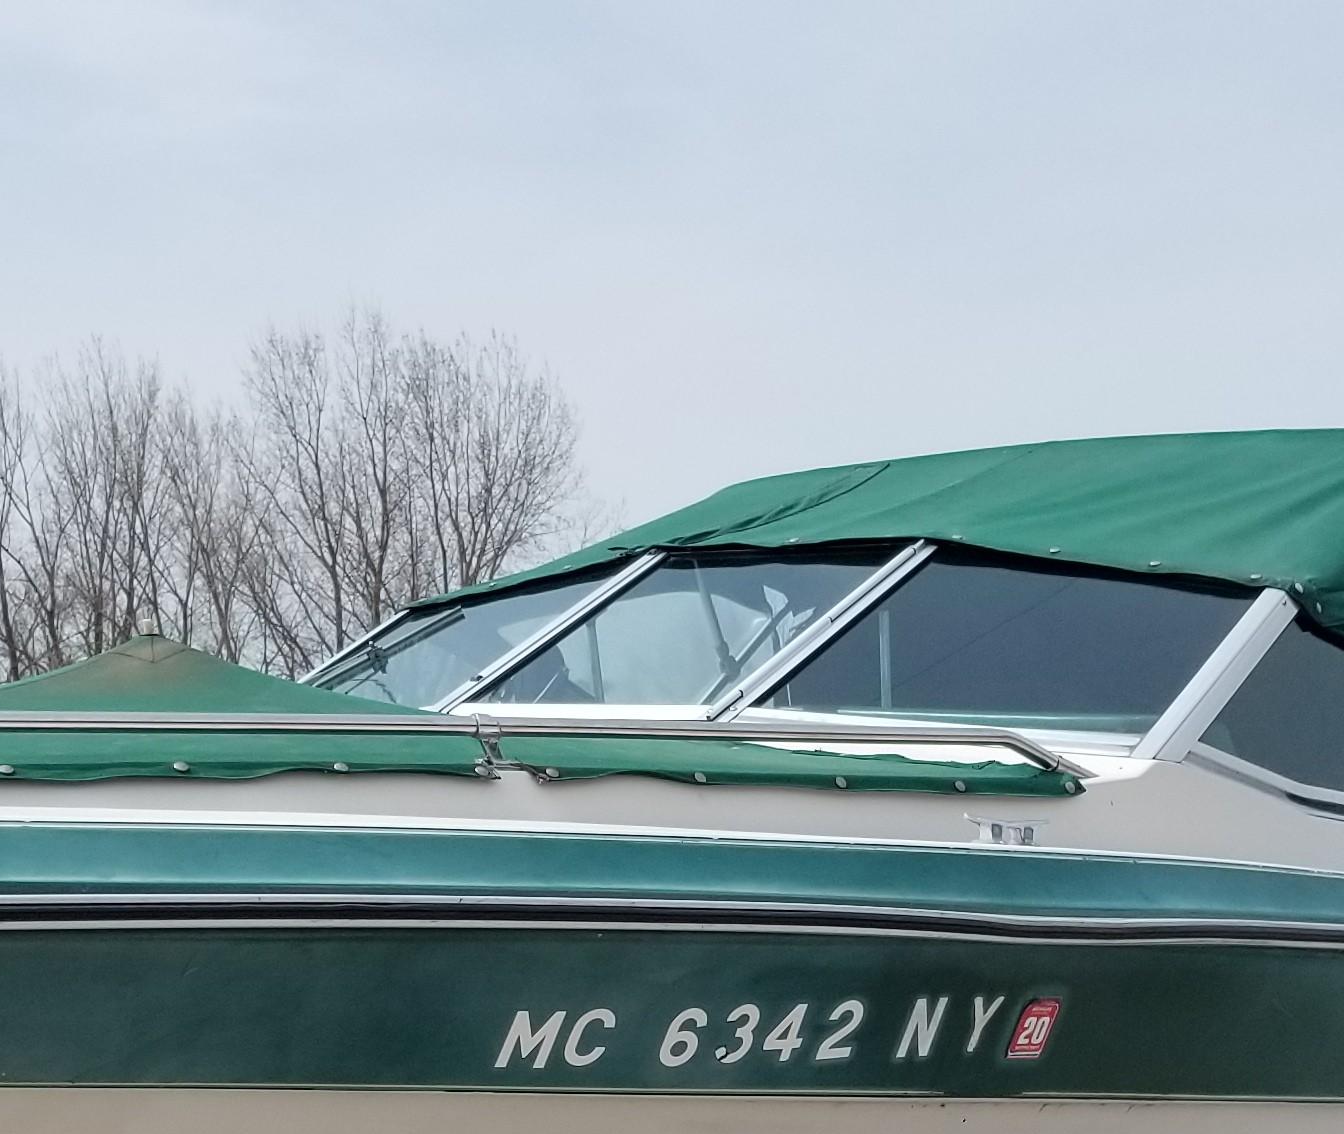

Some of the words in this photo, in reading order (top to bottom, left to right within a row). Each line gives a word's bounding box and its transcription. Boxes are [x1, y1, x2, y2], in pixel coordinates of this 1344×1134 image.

[494, 1008, 616, 1069] MC
[658, 999, 864, 1067] 6342
[896, 996, 1005, 1058] NY
[1016, 1016, 1050, 1045] 20
